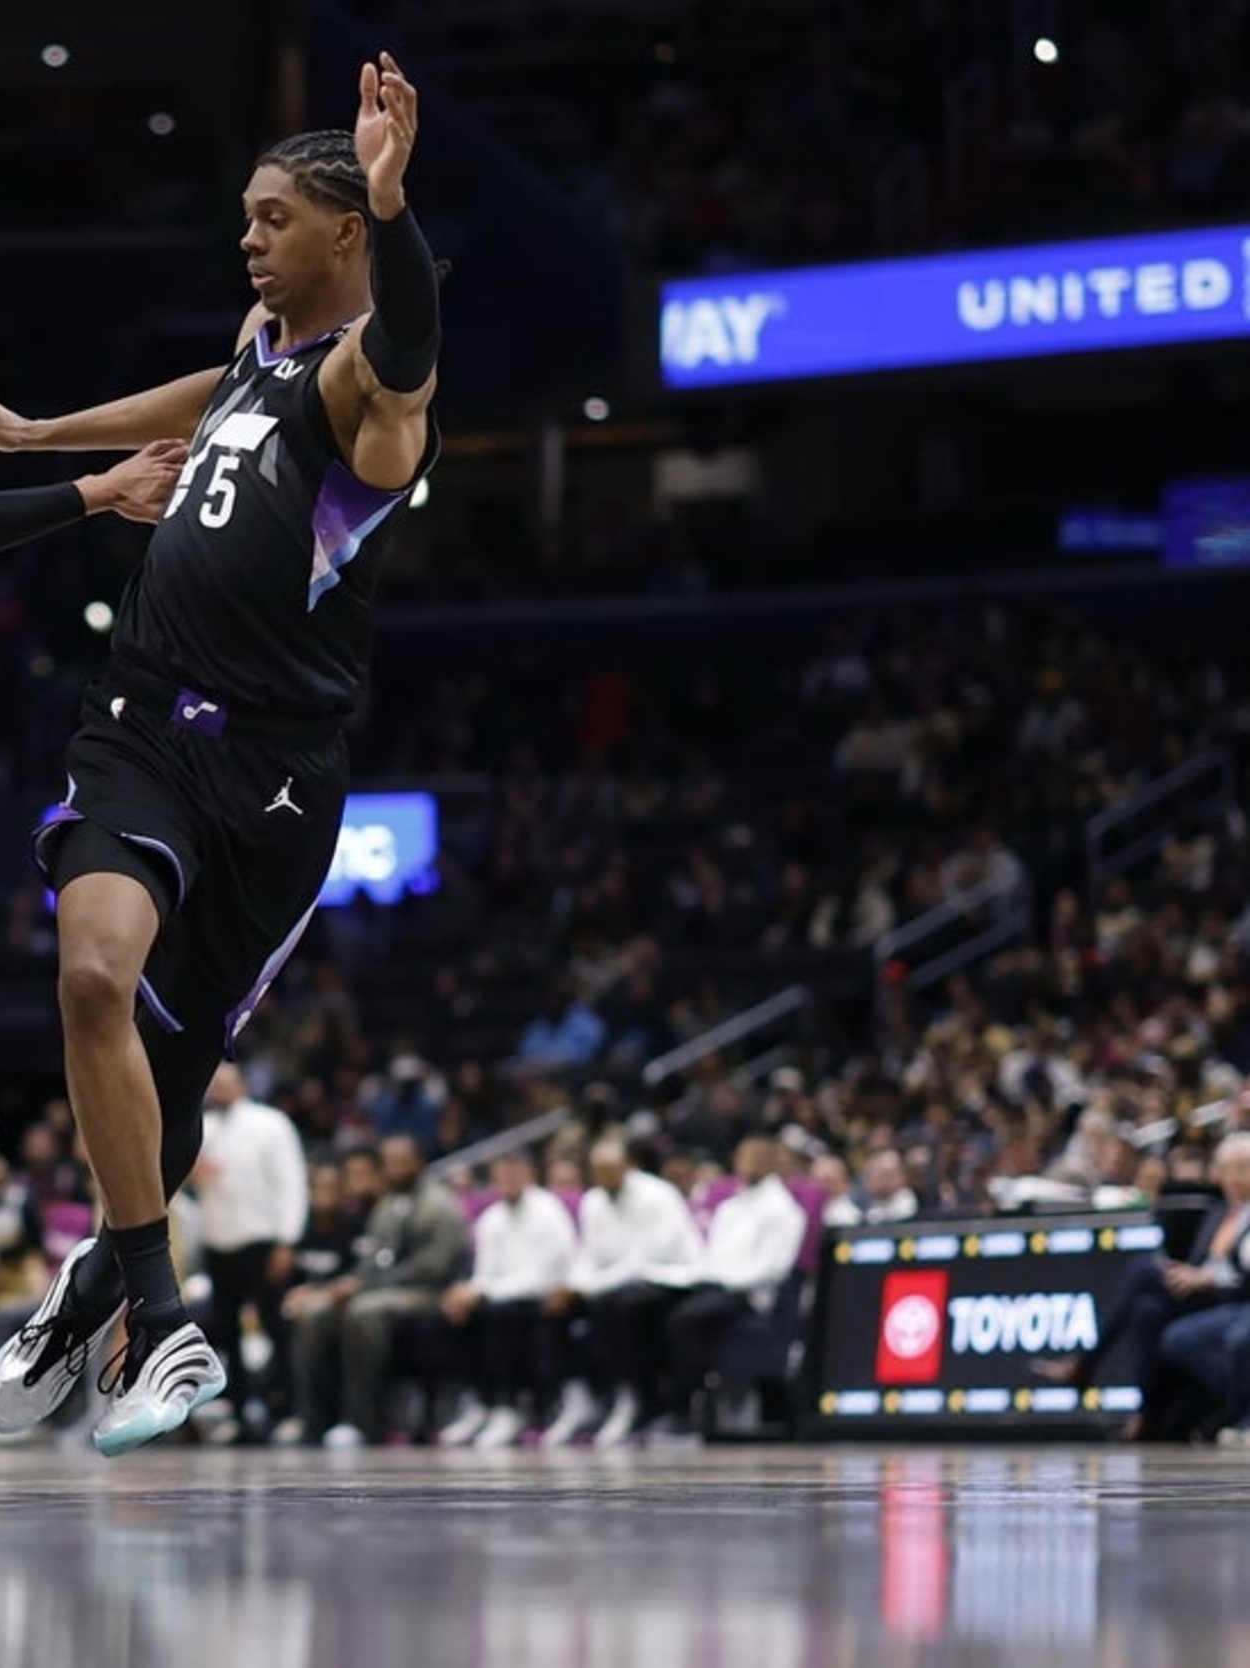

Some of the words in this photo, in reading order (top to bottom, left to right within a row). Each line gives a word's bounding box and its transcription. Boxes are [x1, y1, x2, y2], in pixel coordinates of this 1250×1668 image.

[957, 258, 1232, 331] UNITED
[199, 452, 241, 528] 5
[948, 1291, 1099, 1354] TOYOTA
